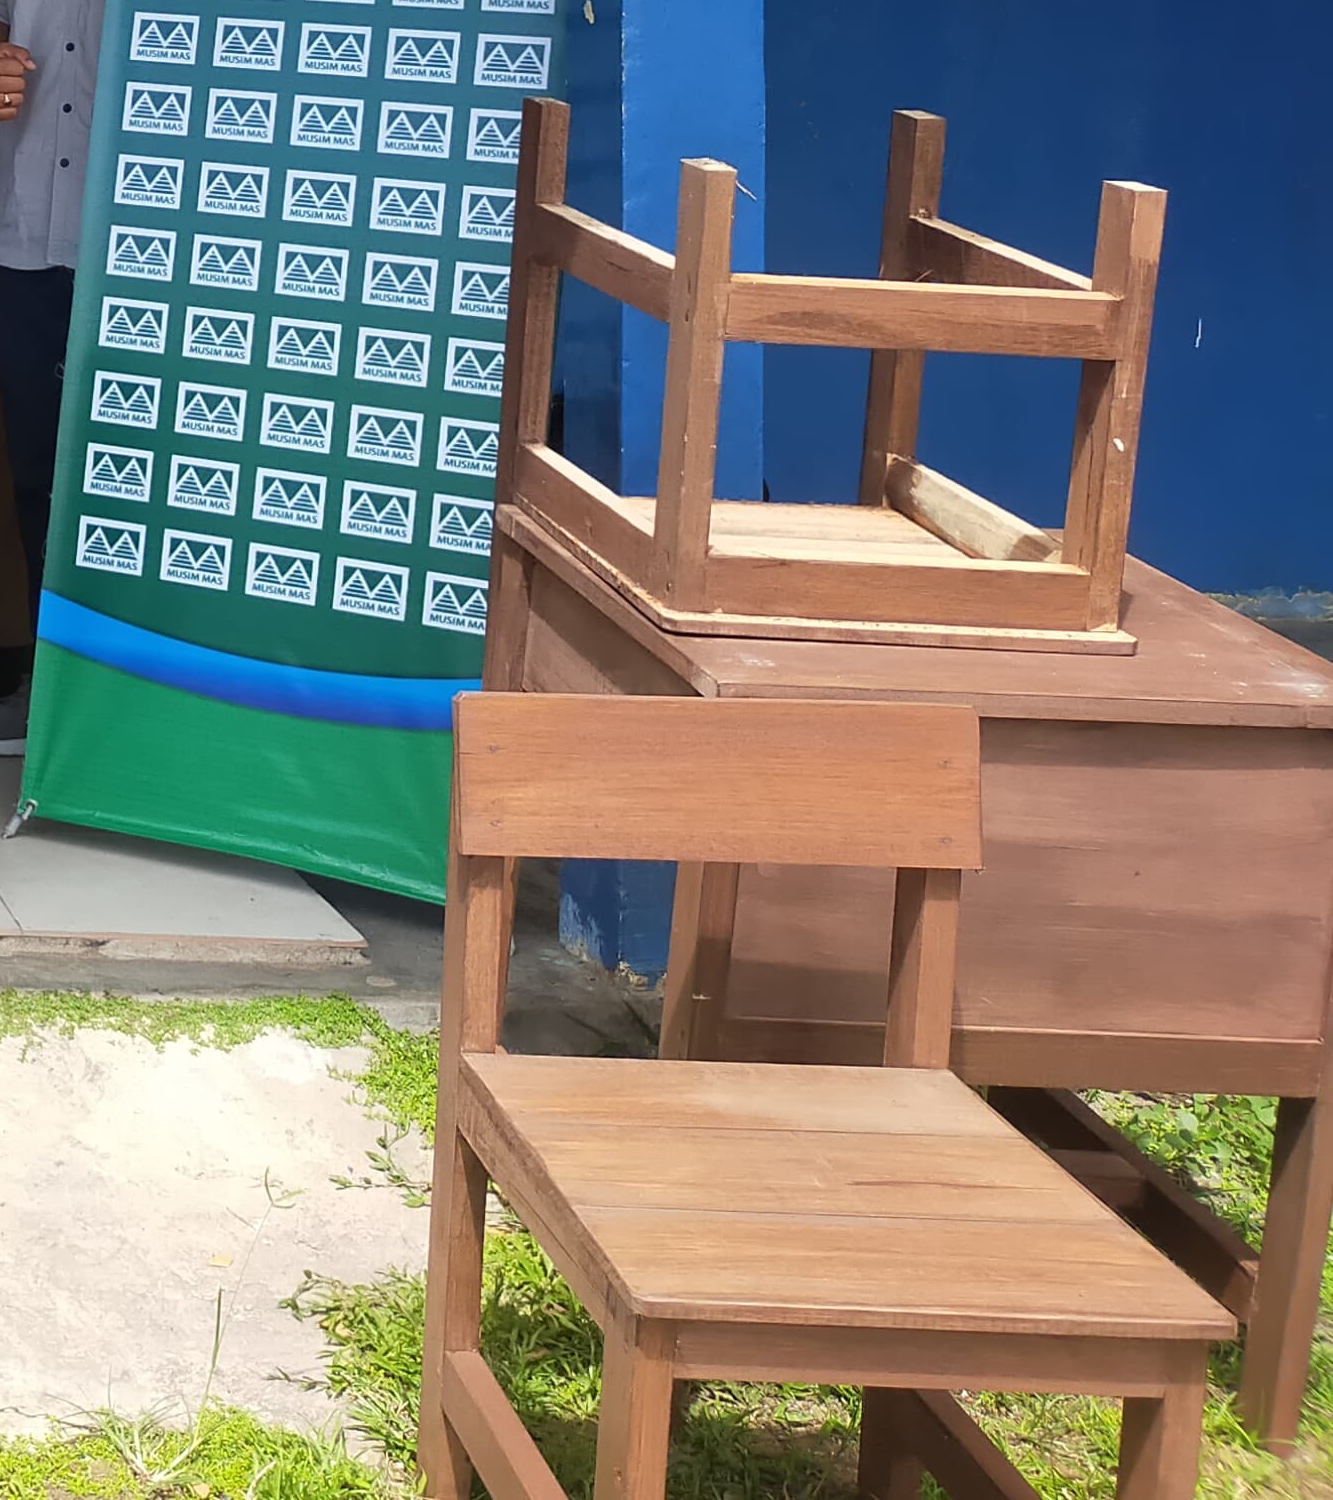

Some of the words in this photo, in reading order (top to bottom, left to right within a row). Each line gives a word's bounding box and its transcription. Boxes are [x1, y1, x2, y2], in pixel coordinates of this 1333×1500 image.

[526, 0, 550, 9] MAS
[137, 49, 169, 59] MUSIM
[170, 51, 191, 60] MAS
[219, 55, 253, 65] MUSIM
[255, 57, 277, 66] MAS
[304, 61, 338, 71] MUSIM
[340, 63, 363, 73] MAS
[392, 66, 427, 77] MUSIM
[429, 69, 452, 79] MAS
[480, 73, 516, 83] MUSIM
[518, 75, 541, 85] MAS
[128, 118, 161, 129] MUSIM
[162, 121, 184, 131] MAS
[211, 126, 245, 137] MUSIM
[246, 129, 269, 139] MAS
[297, 133, 332, 144] MUSIM
[333, 136, 356, 146] MAS
[384, 141, 419, 152] MUSIM
[421, 144, 444, 154] MAS
[474, 148, 510, 159] MUSIM
[120, 191, 153, 202] MUSIM
[154, 195, 176, 205] MAS
[203, 199, 237, 210] MUSIM
[239, 203, 261, 213] MAS
[289, 209, 324, 220] MUSIM
[325, 212, 348, 222] MAS
[376, 217, 412, 228] MUSIM
[414, 220, 437, 231] MAS
[466, 226, 503, 237] MUSIM
[113, 263, 146, 274] MUSIM
[147, 267, 168, 277] MAS
[196, 272, 229, 284] MUSIM
[231, 276, 253, 287] MAS
[281, 282, 316, 294] MUSIM
[317, 286, 340, 297] MAS
[369, 291, 404, 303] MUSIM
[406, 295, 429, 307] MAS
[458, 302, 494, 314] MUSIM
[105, 334, 138, 346] MUSIM
[139, 339, 161, 349] MAS
[189, 345, 222, 357] MUSIM
[224, 349, 246, 360] MAS
[274, 356, 309, 368] MUSIM
[310, 360, 333, 371] MAS
[362, 367, 397, 379] MUSIM
[399, 371, 423, 383] MAS
[451, 378, 487, 391] MUSIM
[97, 409, 129, 422] MUSIM
[130, 414, 152, 425] MAS
[181, 420, 214, 433] MUSIM
[216, 425, 238, 437] MAS
[267, 433, 302, 446] MUSIM
[303, 438, 326, 449] MAS
[353, 445, 389, 458] MUSIM
[391, 450, 414, 461] MAS
[444, 458, 480, 471] MUSIM
[90, 481, 123, 494] MUSIM
[124, 486, 146, 497] MAS
[174, 494, 208, 507] MUSIM
[209, 499, 231, 511] MAS
[259, 507, 294, 520] MUSIM
[295, 512, 318, 524] MAS
[346, 521, 382, 535] MUSIM
[384, 527, 407, 538] MAS
[437, 535, 473, 549] MUSIM
[475, 541, 491, 552] MA
[82, 554, 115, 567] MUSIM
[116, 559, 138, 571] MAS
[166, 567, 200, 581] MUSIM
[201, 574, 224, 585] MAS
[251, 582, 286, 596] MUSIM
[287, 588, 311, 600] MAS
[339, 598, 375, 612] MUSIM
[376, 604, 400, 616] MAS
[429, 613, 466, 627] MUSIM
[467, 619, 486, 631] MA
